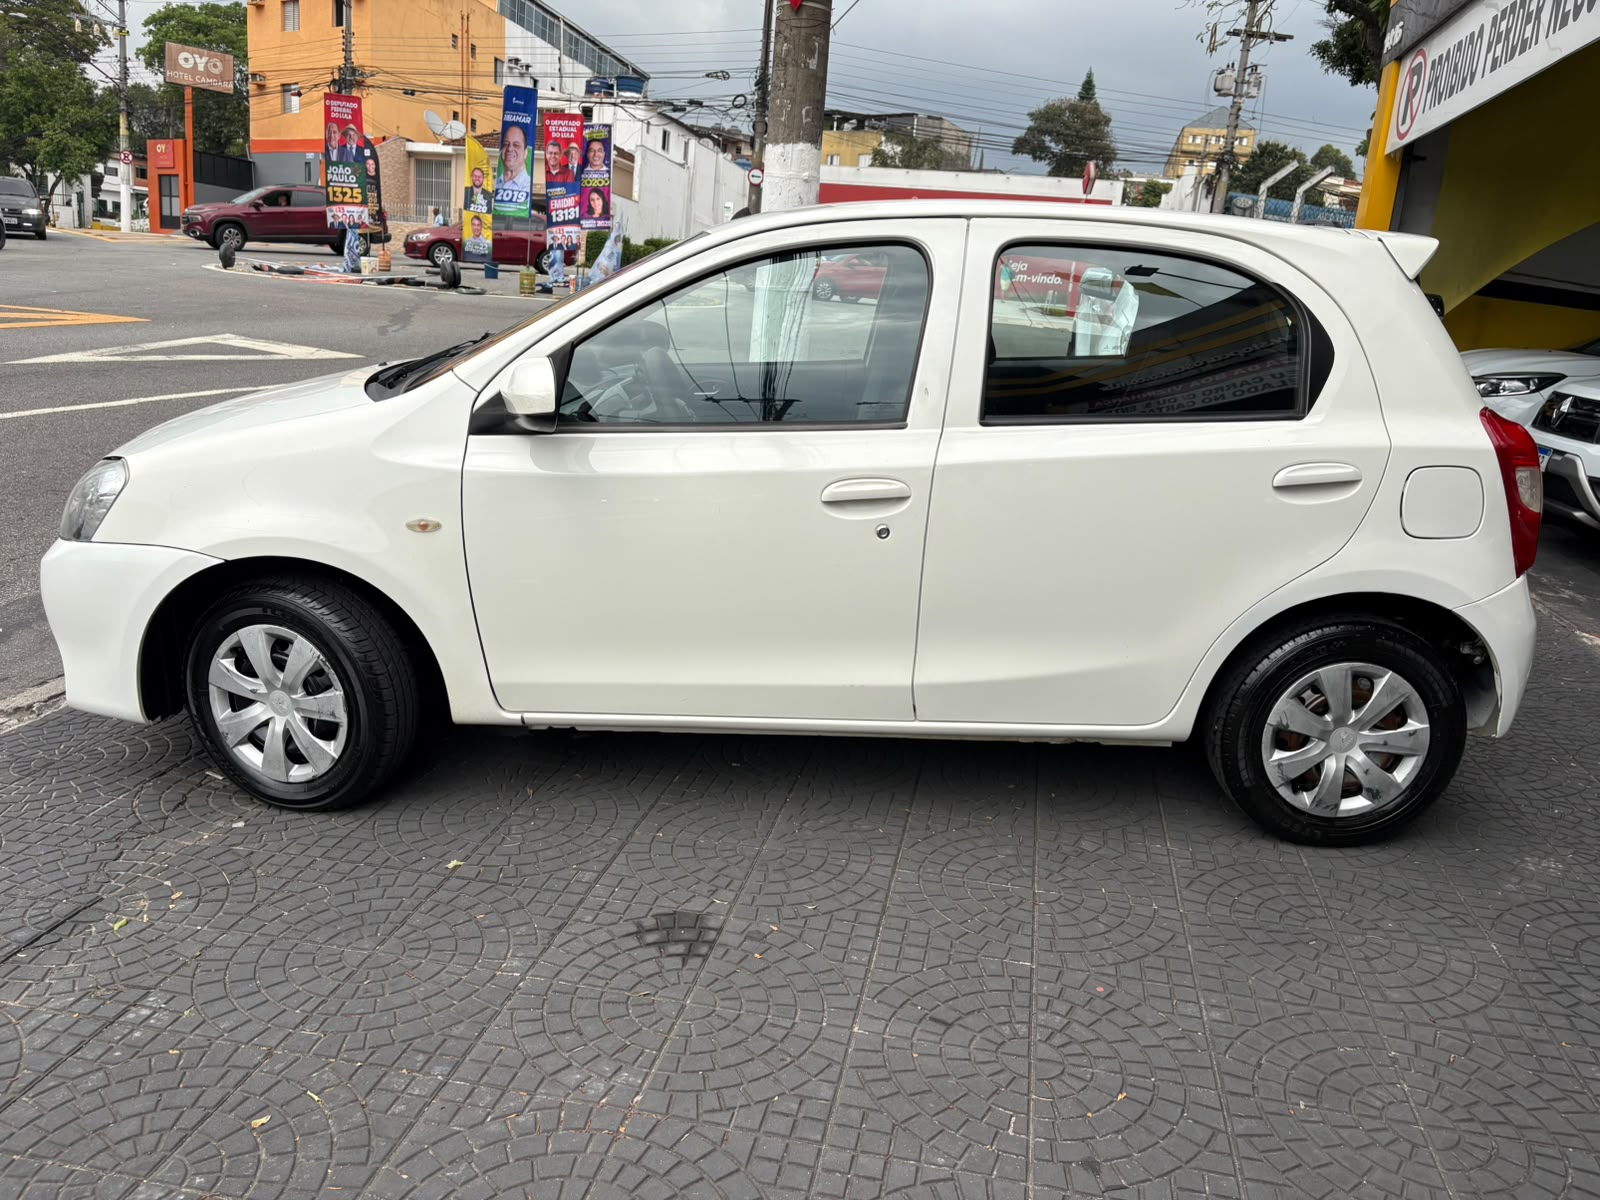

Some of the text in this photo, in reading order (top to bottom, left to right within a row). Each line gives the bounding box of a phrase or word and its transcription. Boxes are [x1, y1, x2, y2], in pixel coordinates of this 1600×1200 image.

[178, 51, 224, 75] OYO
[1422, 23, 1485, 115] PROIBIDO
[1481, 0, 1546, 79] PERDER
[166, 70, 193, 82] HOTEL
[331, 100, 358, 109] DEPUTADO
[327, 164, 351, 175] JOÃO
[327, 174, 356, 183] PAULO
[327, 186, 363, 204] 1325
[495, 188, 527, 203] 2019
[551, 196, 575, 210] EMIDIO
[551, 207, 580, 223] 13131
[1010, 260, 1028, 271] eja
[1013, 273, 1063, 285] m-vindo.
